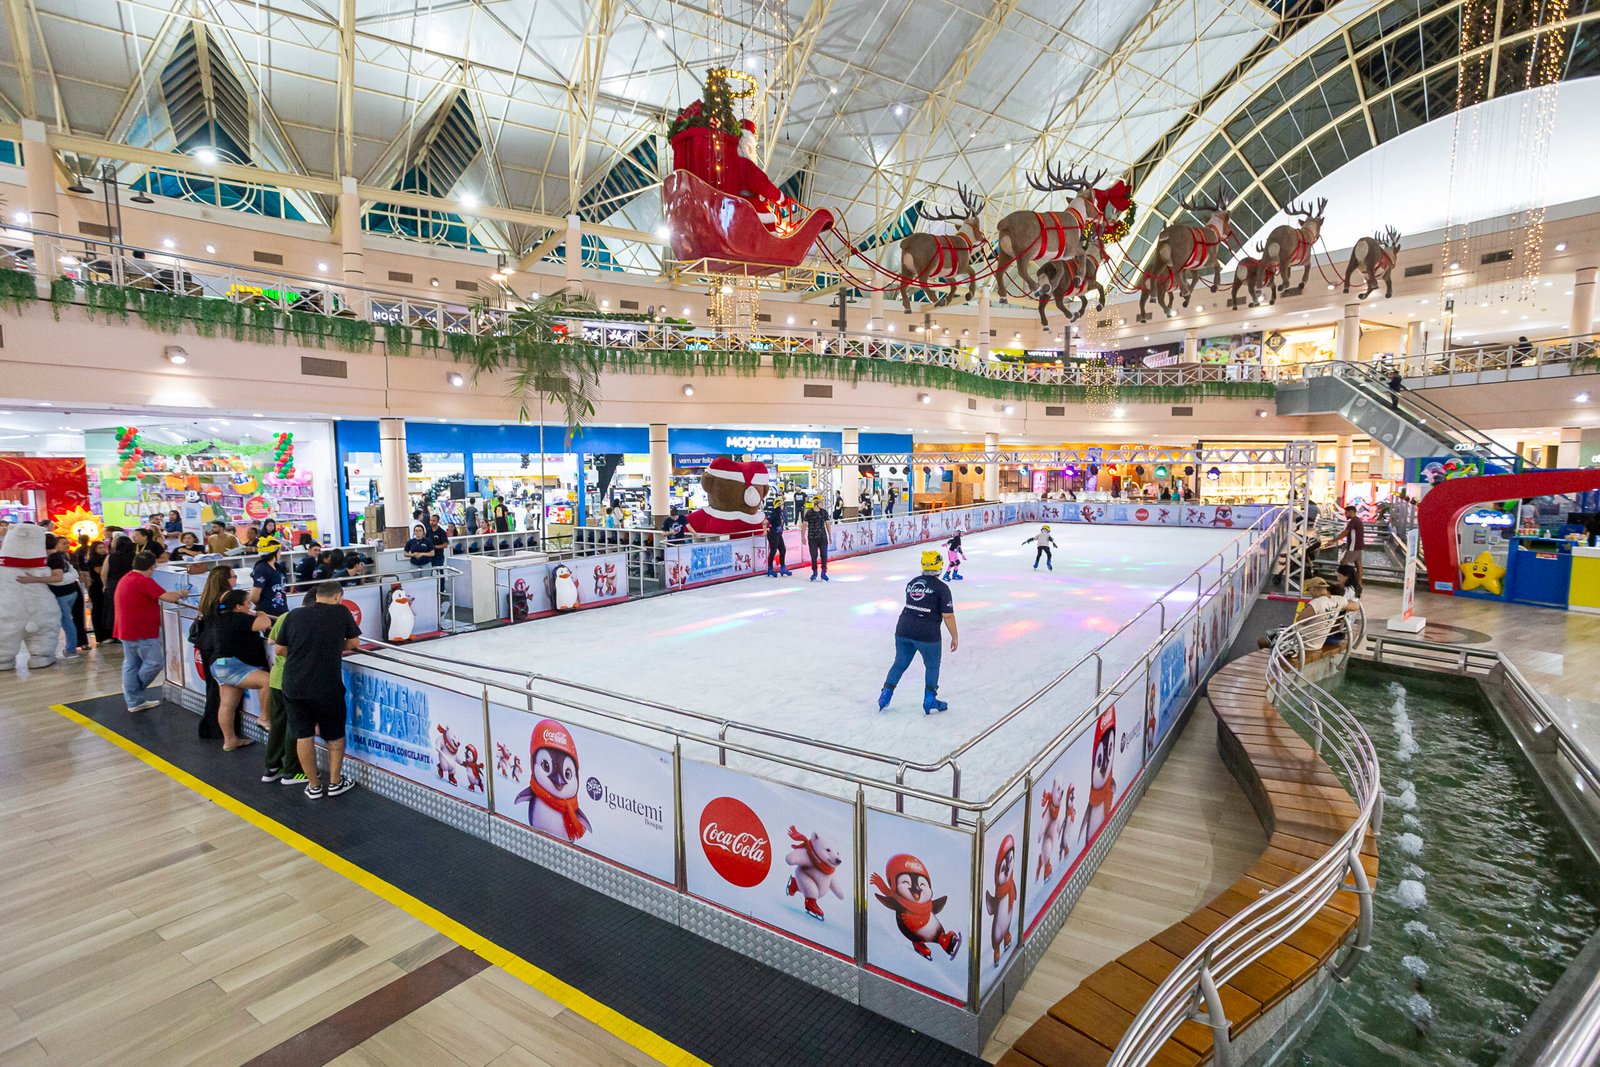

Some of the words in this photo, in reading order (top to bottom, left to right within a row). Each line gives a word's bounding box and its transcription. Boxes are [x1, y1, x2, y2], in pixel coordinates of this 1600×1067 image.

[379, 704, 431, 749] PARK
[368, 738, 396, 753] AVENTURA
[397, 747, 430, 763] CONGELANTE
[604, 785, 663, 823] Iguatemi
[644, 817, 664, 831] Bosque
[703, 822, 769, 862] Coca-Cola
